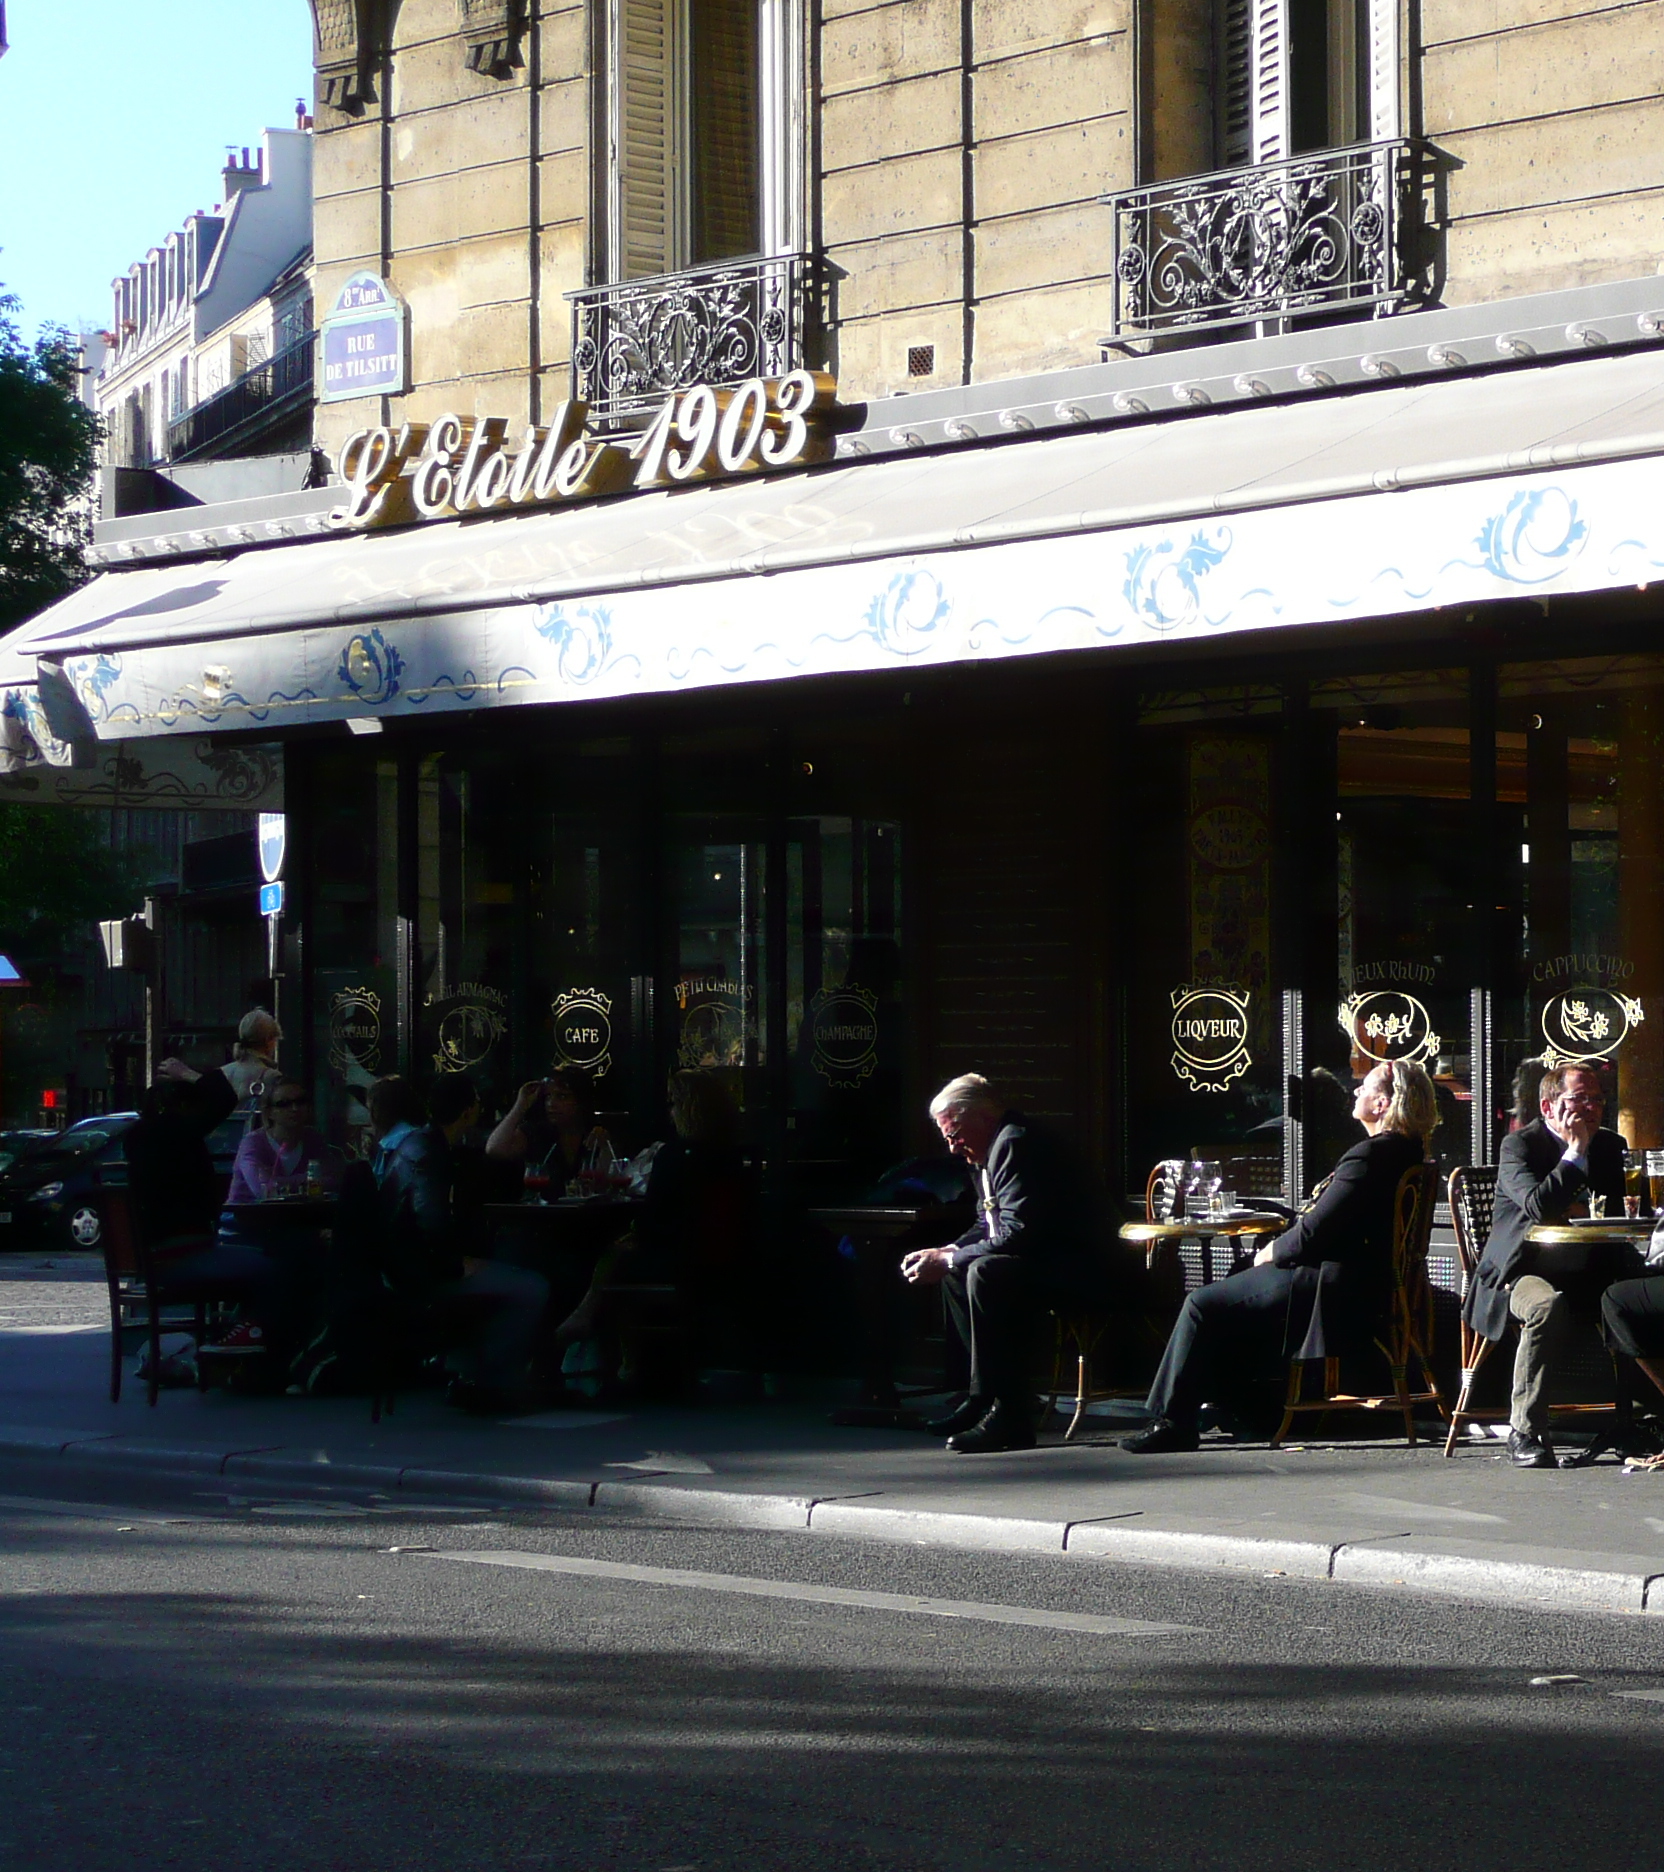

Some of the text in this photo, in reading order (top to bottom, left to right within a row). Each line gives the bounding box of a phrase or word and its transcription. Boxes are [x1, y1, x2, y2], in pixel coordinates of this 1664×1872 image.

[347, 333, 375, 354] RUE
[326, 354, 397, 381] DE TILSITT
[329, 369, 816, 528] L'Etoile 1903
[1533, 953, 1635, 982] CAPPUCCINO
[564, 1026, 600, 1044] CAFE
